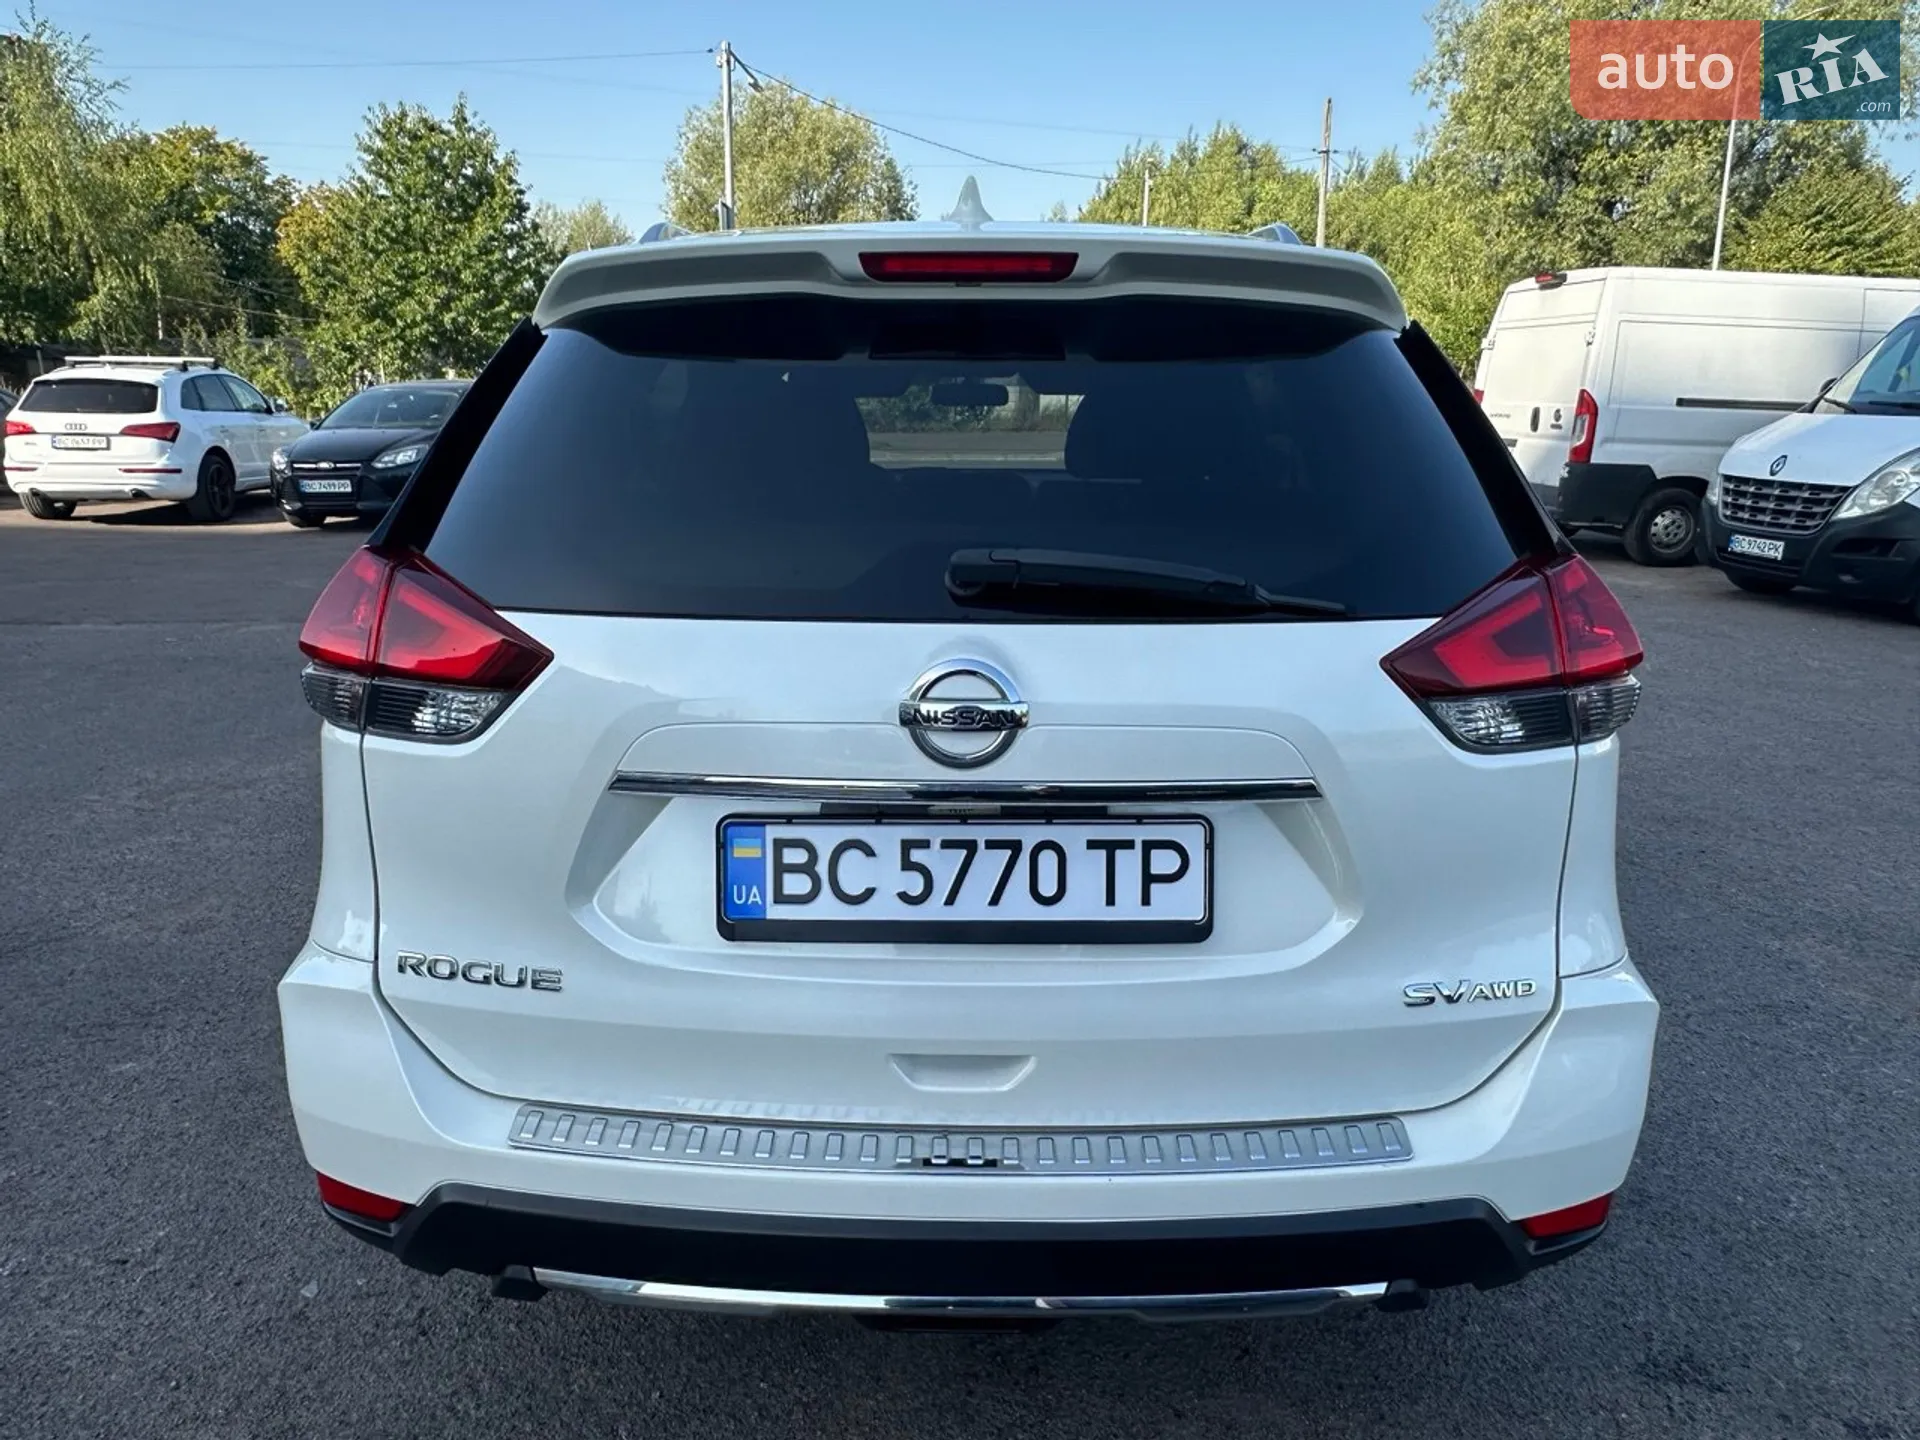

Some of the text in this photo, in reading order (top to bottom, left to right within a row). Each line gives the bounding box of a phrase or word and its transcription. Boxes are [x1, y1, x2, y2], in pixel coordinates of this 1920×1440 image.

[1747, 538, 1767, 553] 9742
[912, 705, 1017, 728] NISSAN
[772, 837, 1190, 907] BC 5770 TP
[732, 884, 763, 905] UA
[396, 949, 564, 993] ROGUE
